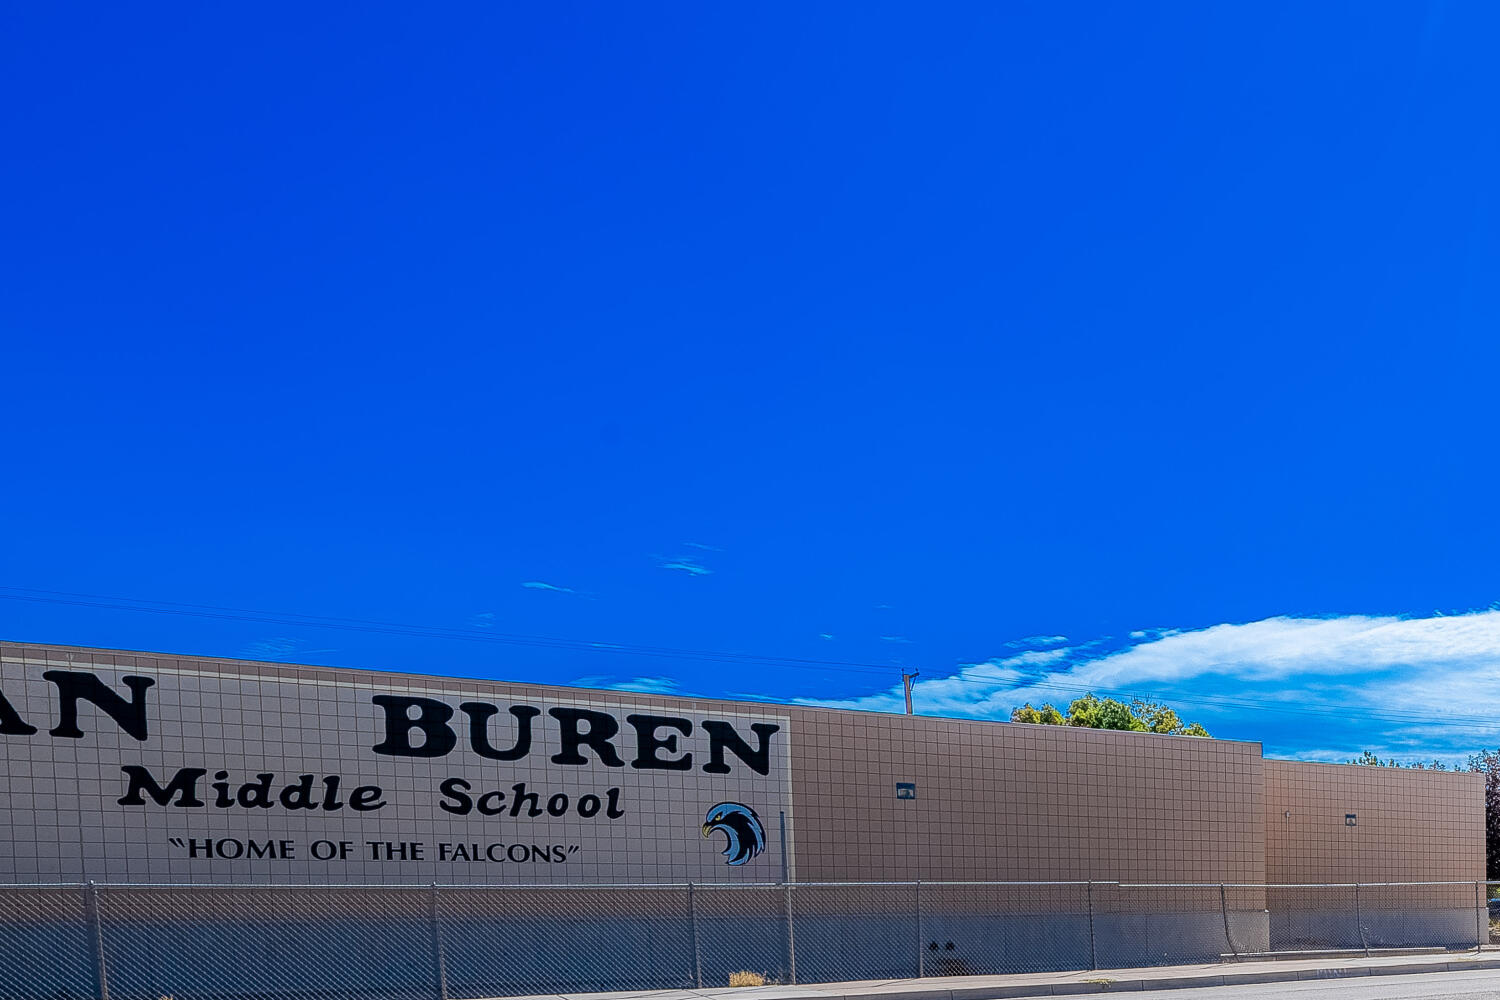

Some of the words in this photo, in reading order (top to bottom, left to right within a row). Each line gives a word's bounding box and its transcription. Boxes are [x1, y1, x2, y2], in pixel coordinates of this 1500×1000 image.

[371, 694, 780, 776] BUREN
[118, 765, 387, 812] Middle
[439, 777, 625, 820] School
[168, 837, 296, 861] "HOME
[310, 840, 354, 861] OF
[365, 841, 425, 862] THE
[438, 842, 580, 864] FALCONS"
